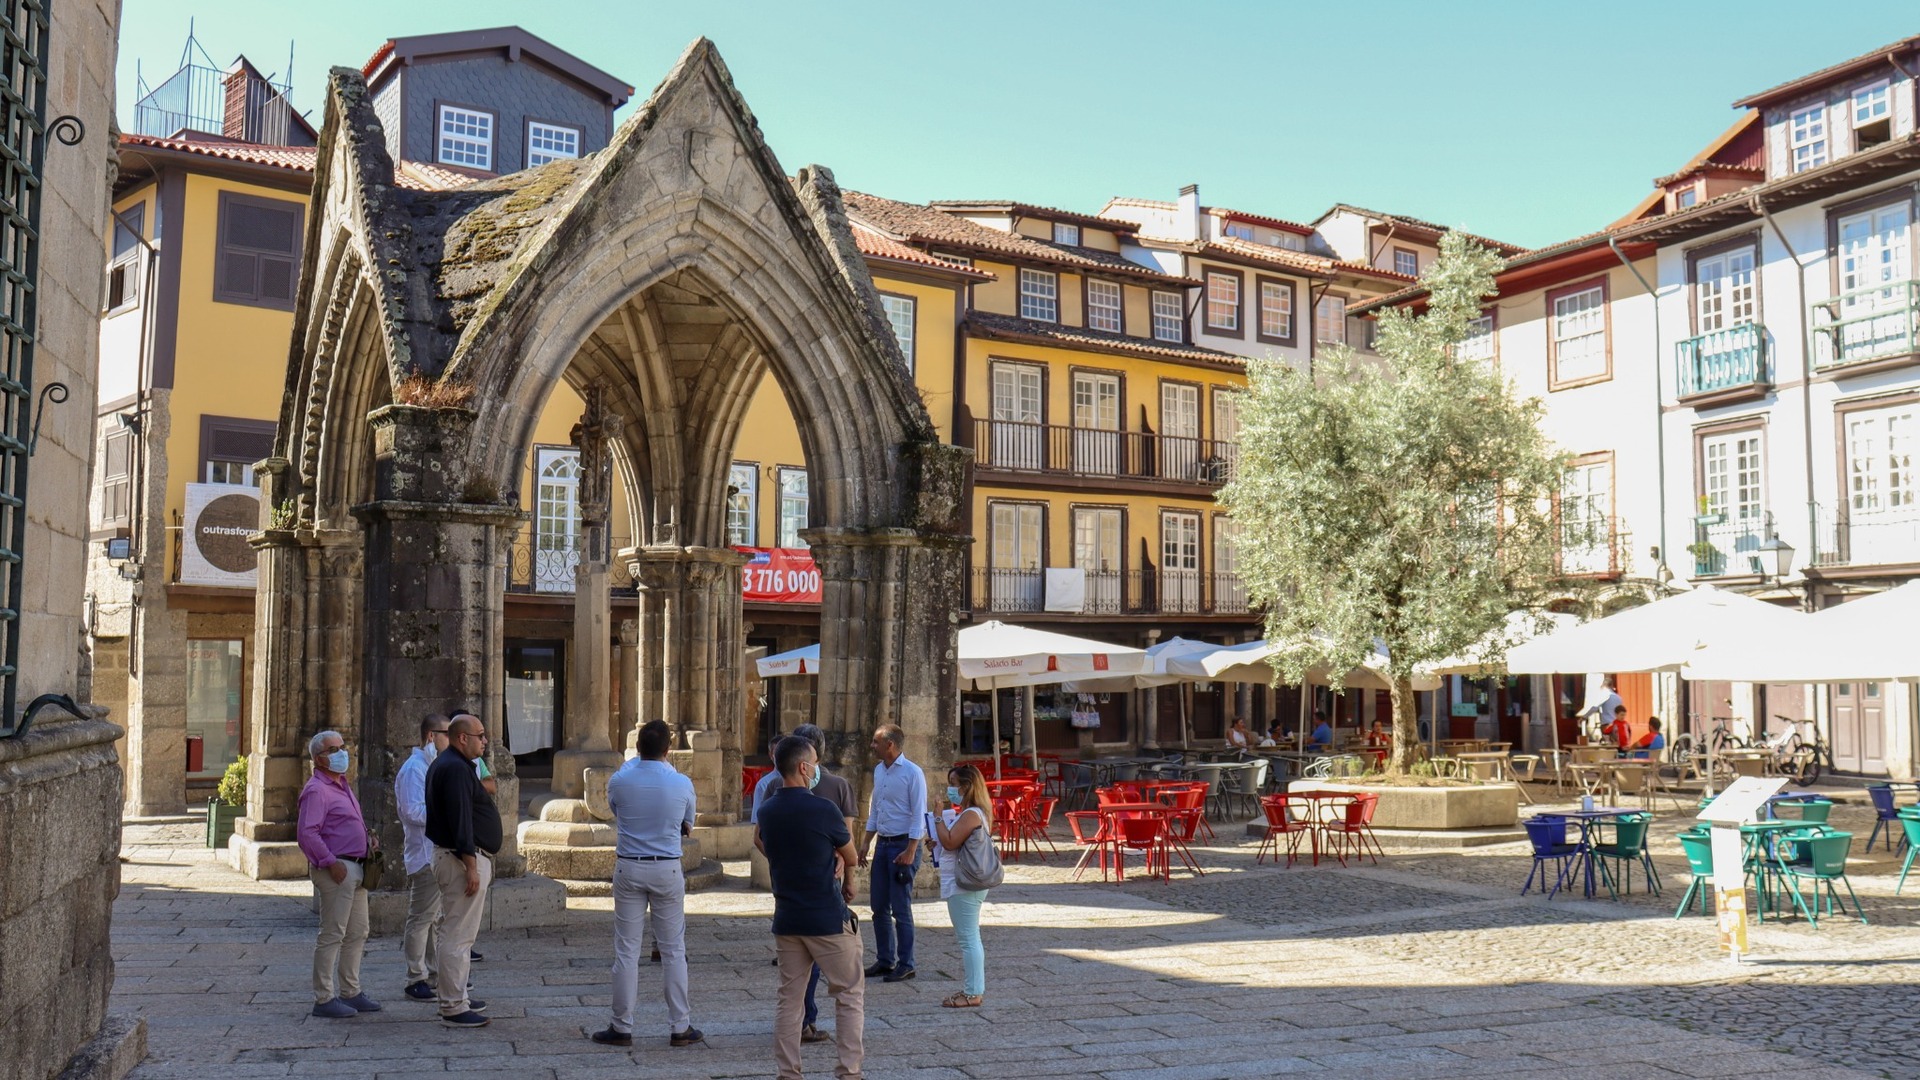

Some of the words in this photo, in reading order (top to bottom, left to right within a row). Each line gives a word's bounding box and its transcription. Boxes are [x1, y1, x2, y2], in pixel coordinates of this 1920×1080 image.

[743, 568, 753, 592] 3
[757, 569, 784, 593] 776
[788, 570, 819, 593] 000
[984, 659, 1009, 669] Salado
[1011, 659, 1023, 667] Bar
